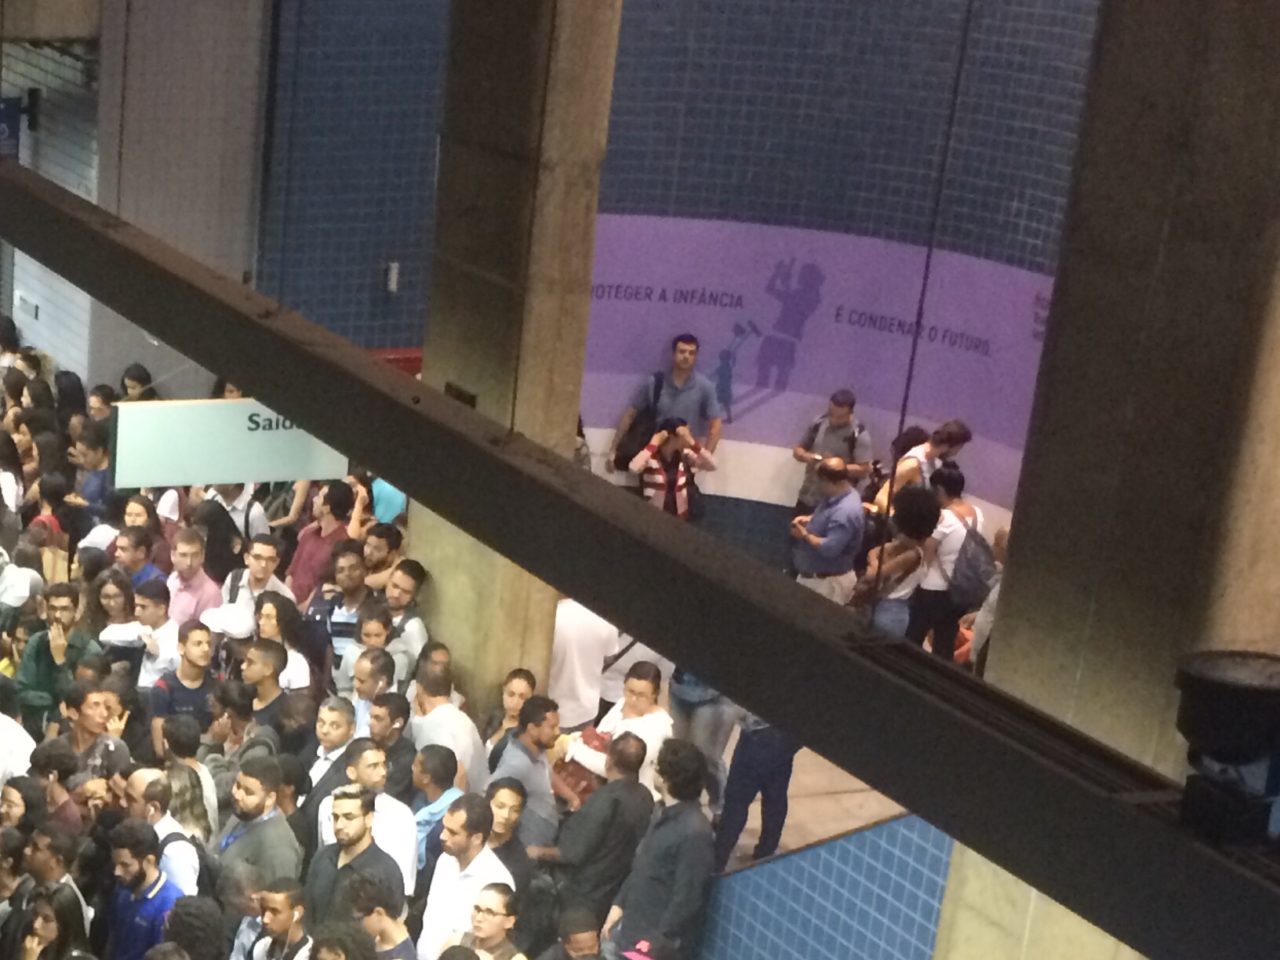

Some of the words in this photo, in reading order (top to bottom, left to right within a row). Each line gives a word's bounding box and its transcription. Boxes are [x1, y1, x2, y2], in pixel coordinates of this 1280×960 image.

[591, 283, 654, 302] OTEGER
[658, 287, 668, 304] A
[928, 325, 938, 343] O
